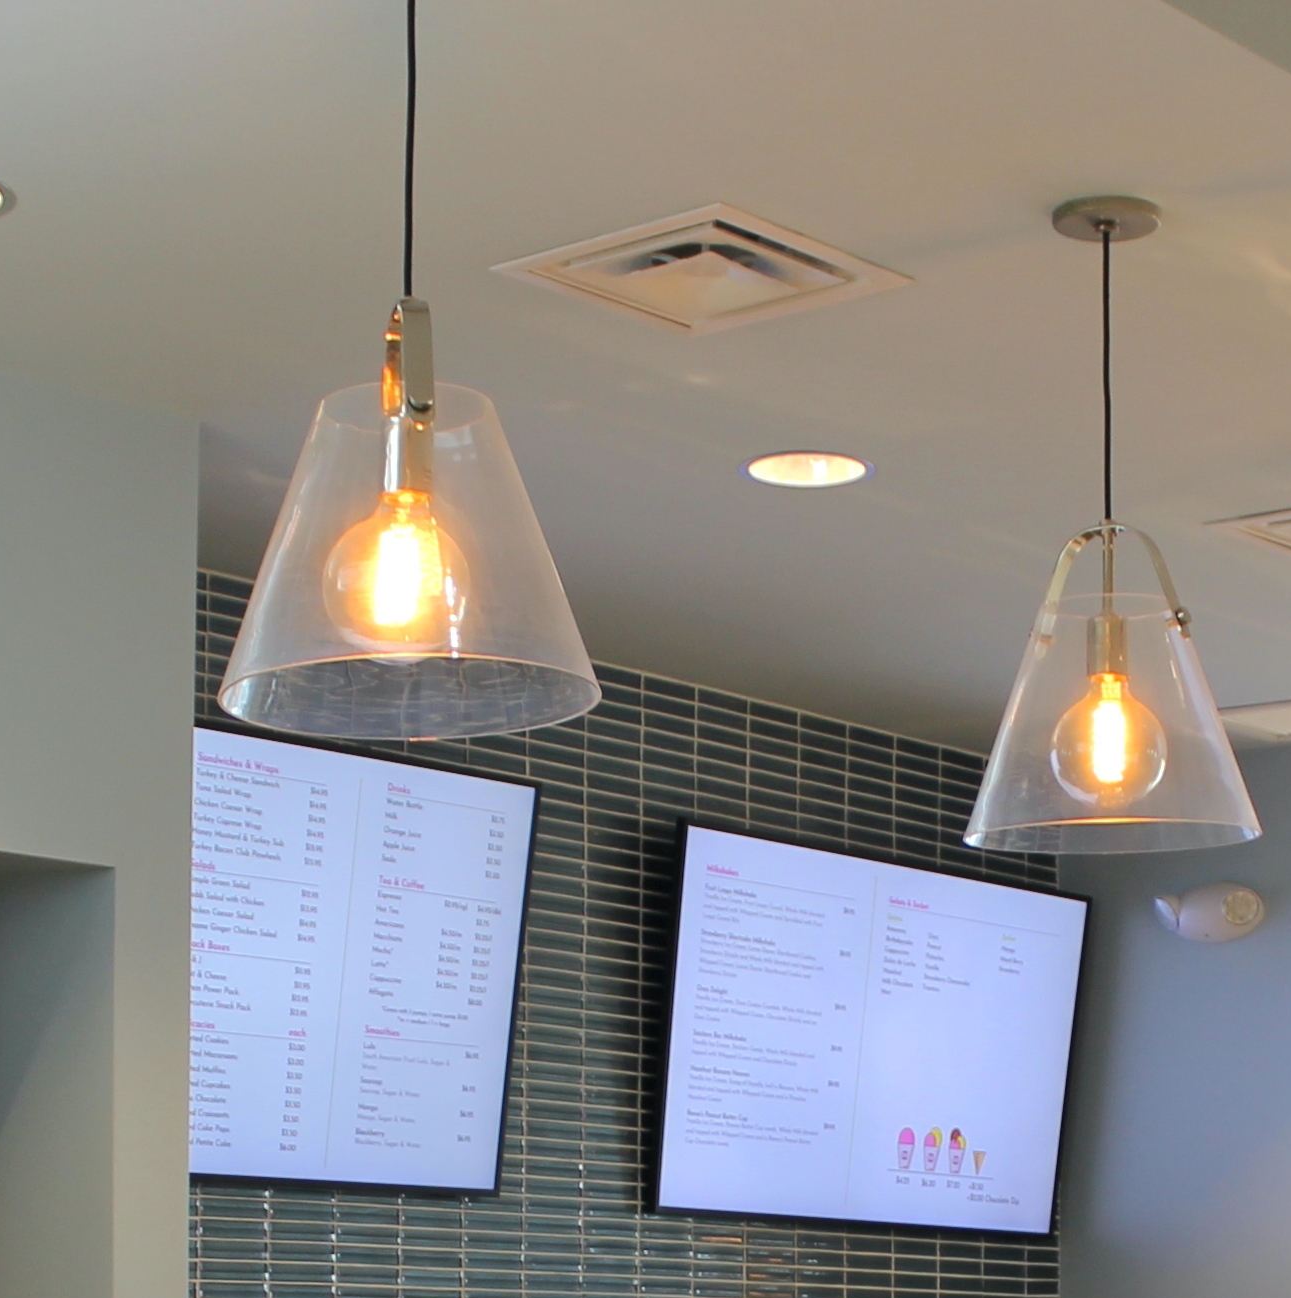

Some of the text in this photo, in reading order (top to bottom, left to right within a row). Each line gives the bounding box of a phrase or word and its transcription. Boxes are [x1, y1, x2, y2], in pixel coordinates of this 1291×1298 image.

[197, 751, 279, 774] Sandwiches & Wraps
[196, 767, 217, 779] Turkey
[250, 776, 279, 788] Sandwich
[194, 797, 219, 808] Chicken
[378, 874, 392, 885] Tea
[400, 878, 424, 889] Coffee
[364, 1024, 400, 1036] Smoothies
